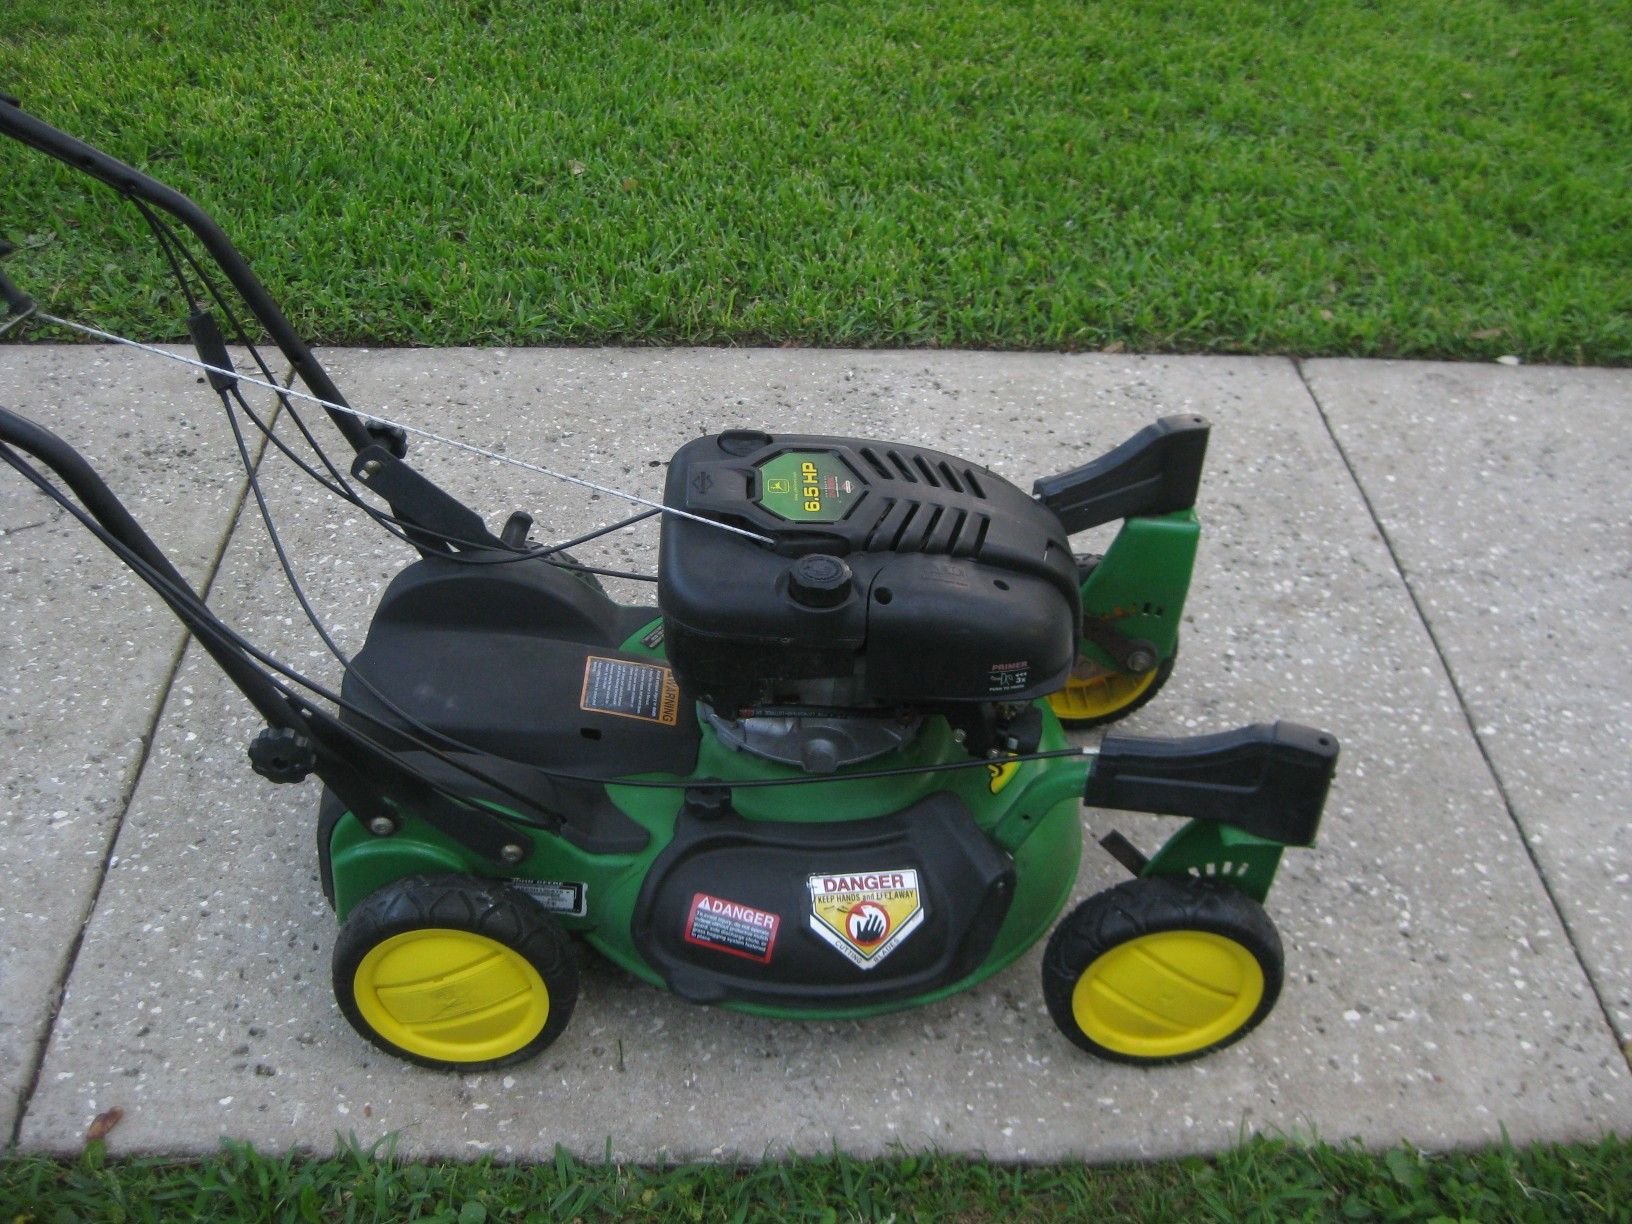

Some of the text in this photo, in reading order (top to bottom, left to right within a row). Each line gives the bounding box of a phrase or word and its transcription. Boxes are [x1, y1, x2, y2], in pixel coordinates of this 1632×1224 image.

[801, 462, 820, 512] 6.5 HP
[992, 661, 1028, 670] PRIMER
[823, 874, 905, 893] DANGER
[817, 895, 835, 905] KEEP
[837, 893, 860, 903] HANDS
[863, 893, 875, 901] and
[894, 889, 914, 899] AWAY
[712, 900, 775, 929] DANGER
[835, 941, 862, 964] CUTTING
[874, 938, 899, 963] BLADES
